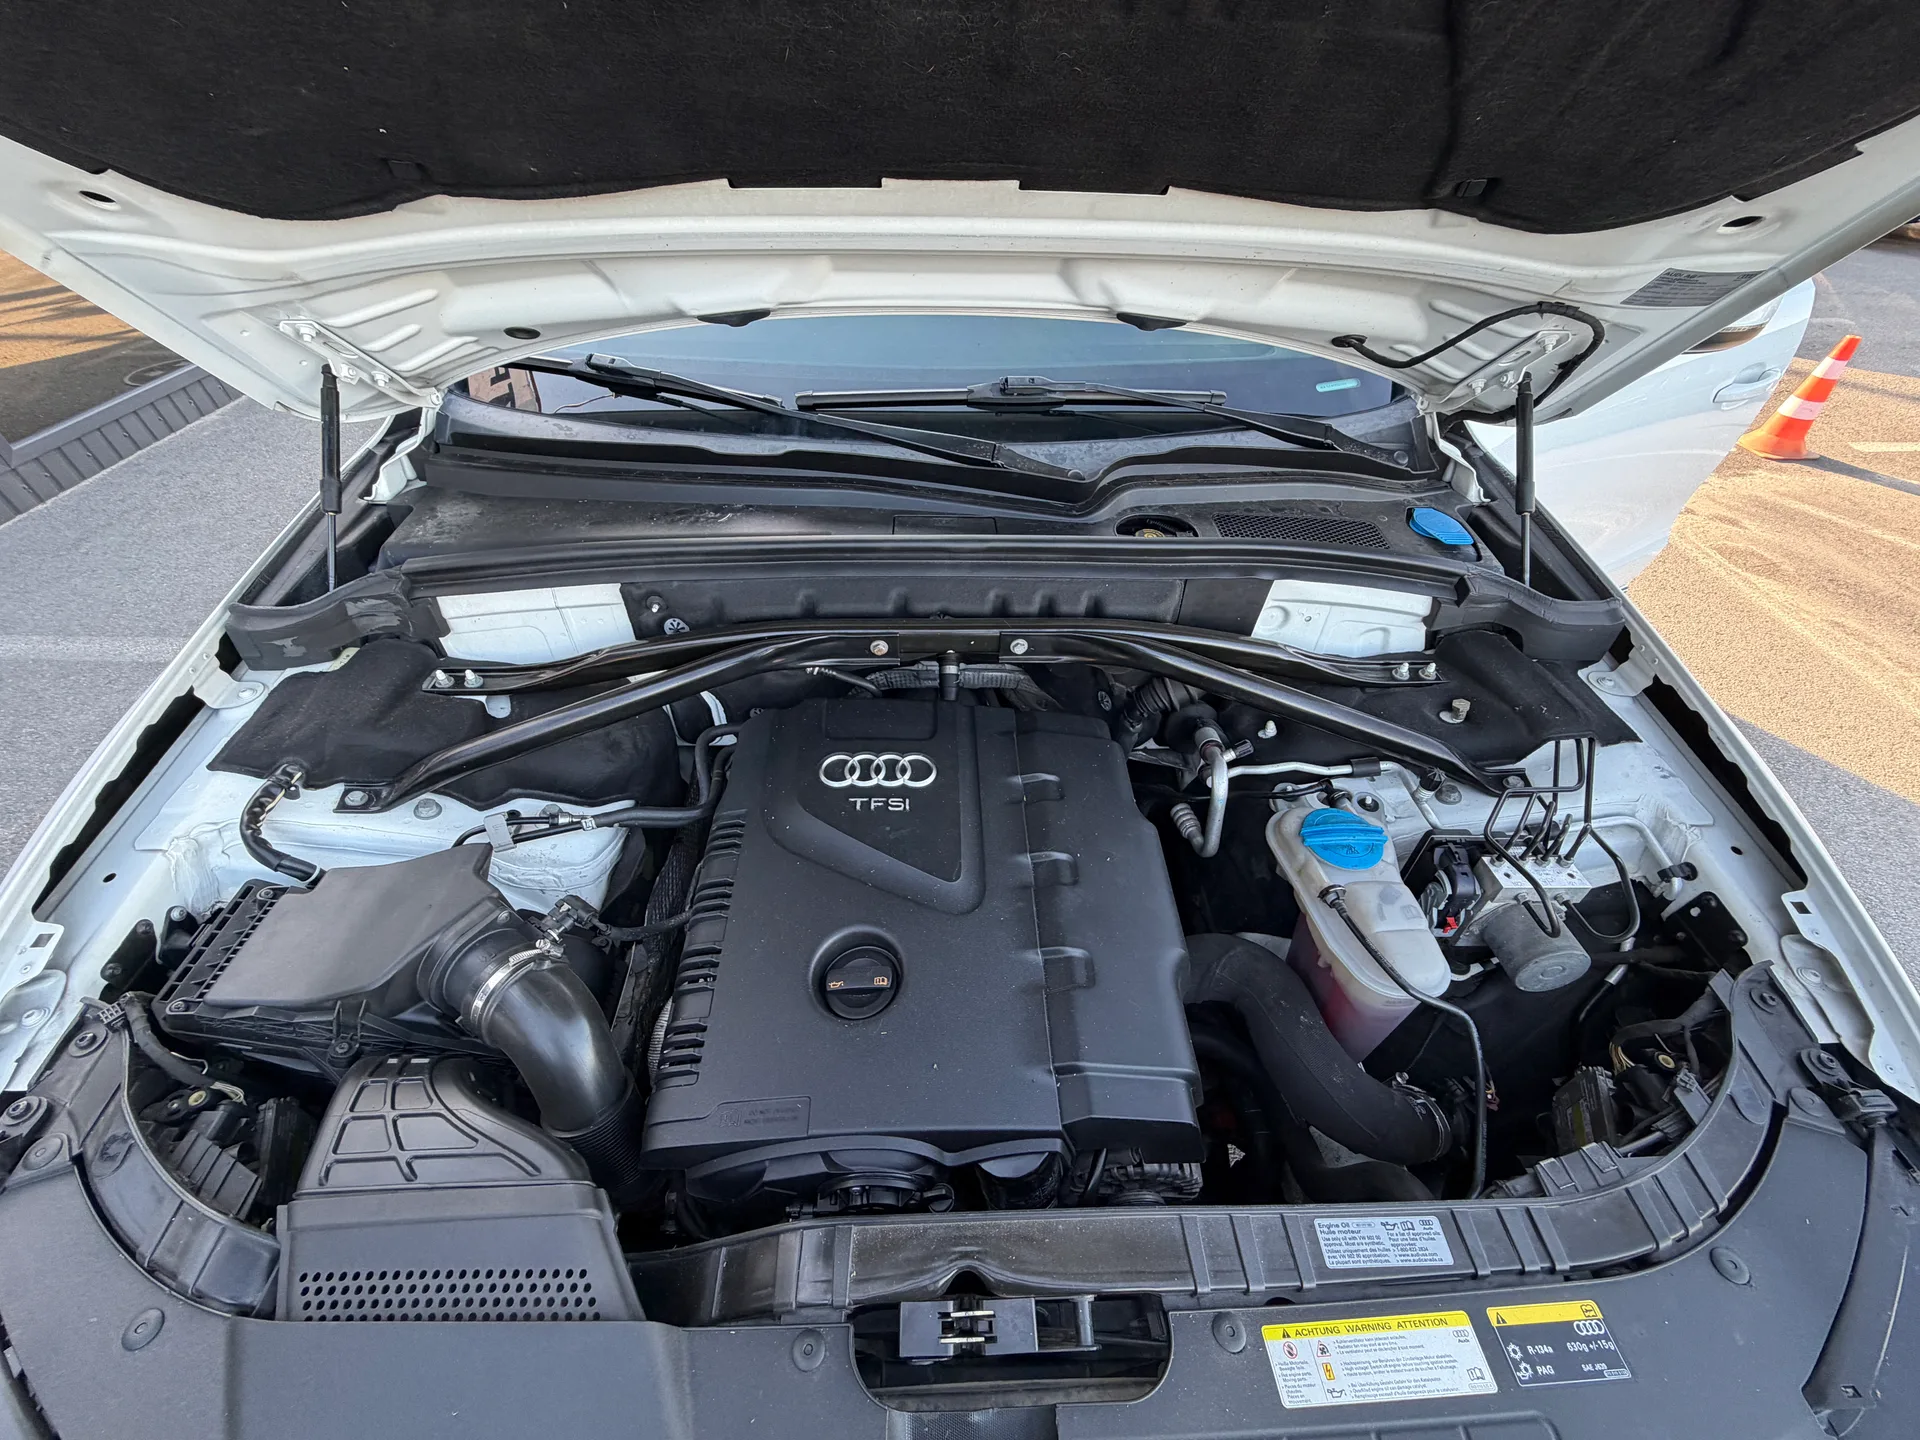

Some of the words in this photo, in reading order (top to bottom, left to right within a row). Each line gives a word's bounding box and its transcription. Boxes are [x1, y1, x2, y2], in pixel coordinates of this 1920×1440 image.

[848, 798, 910, 811] TFSI
[1294, 1326, 1340, 1337] ACHTUNG
[1344, 1322, 1392, 1333] WARNING
[1396, 1318, 1448, 1329] ATTENTION
[1527, 1344, 1554, 1355] R-134a
[1566, 1342, 1589, 1352] 630g
[1536, 1365, 1555, 1375] PAG
[1582, 1363, 1594, 1372] SAE
